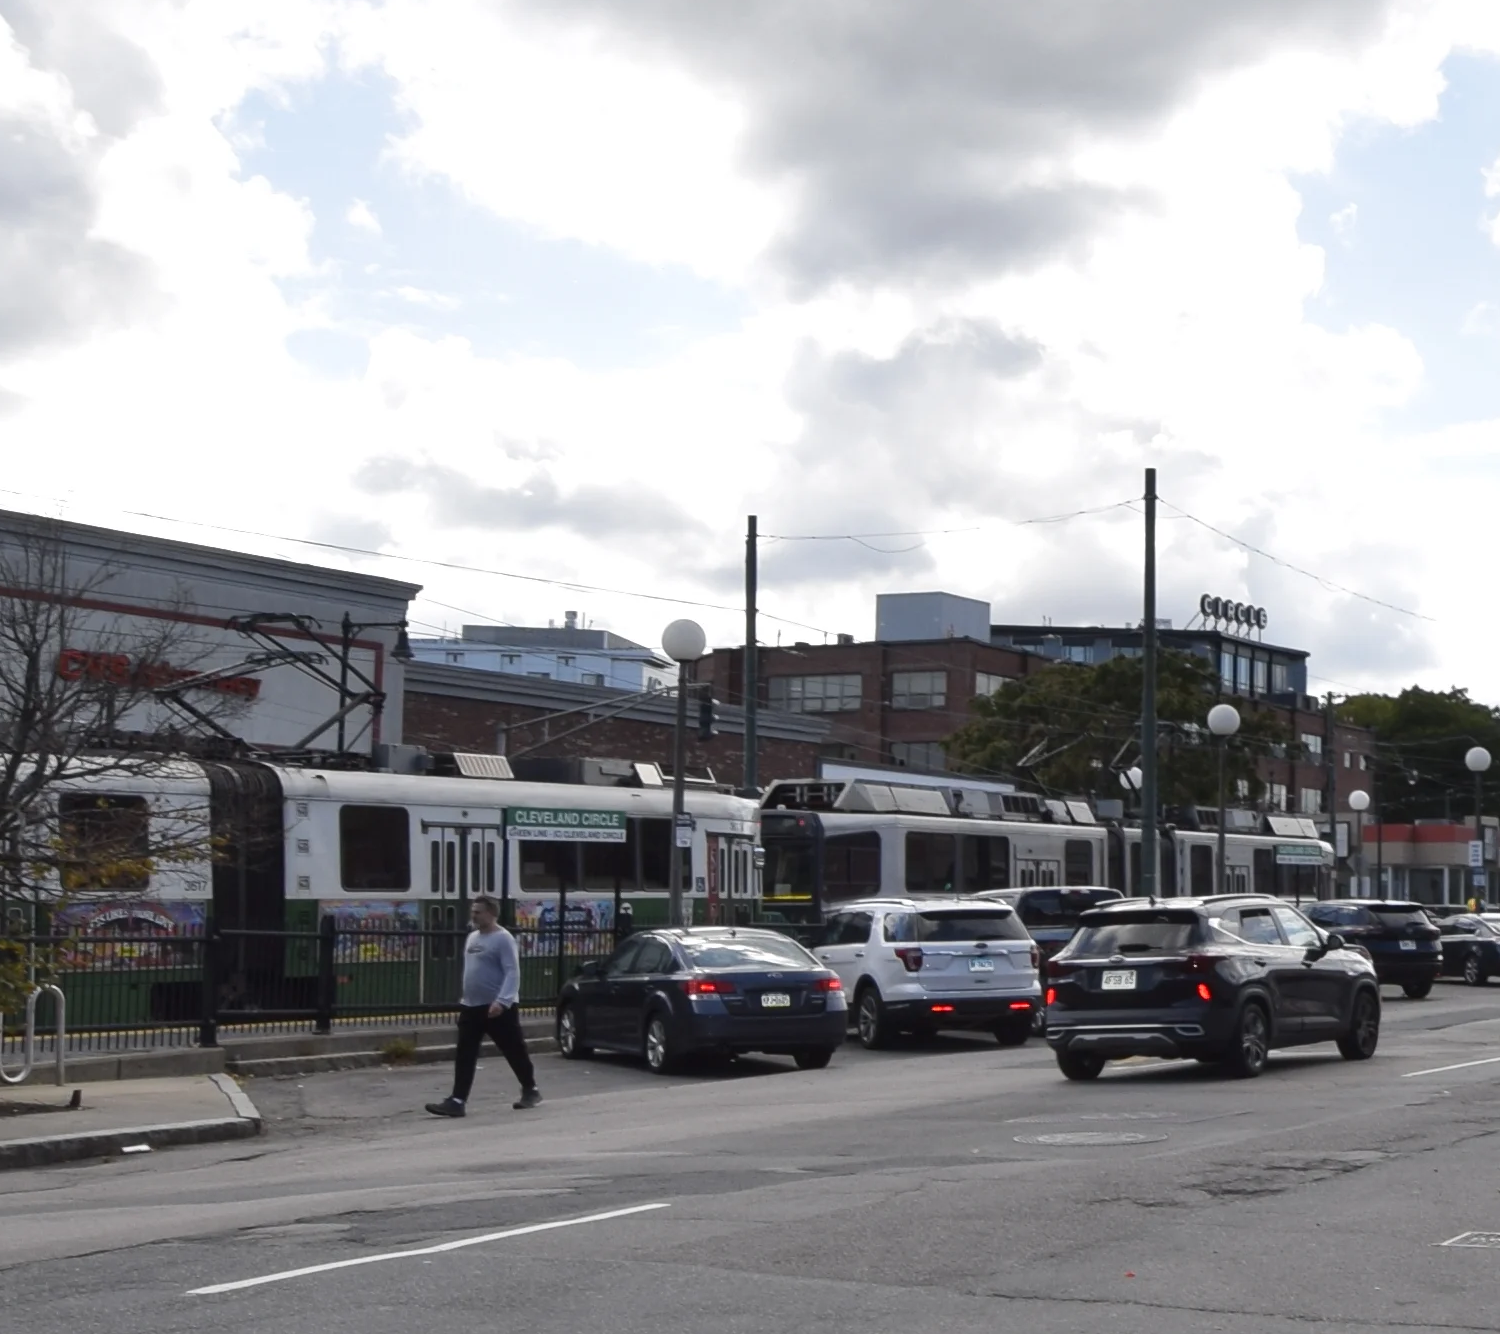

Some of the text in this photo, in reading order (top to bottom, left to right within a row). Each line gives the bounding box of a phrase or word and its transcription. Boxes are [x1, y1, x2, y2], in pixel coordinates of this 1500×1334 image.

[1202, 595, 1267, 628] CIRCLE
[515, 810, 619, 826] CLEVELAND CIRCLE
